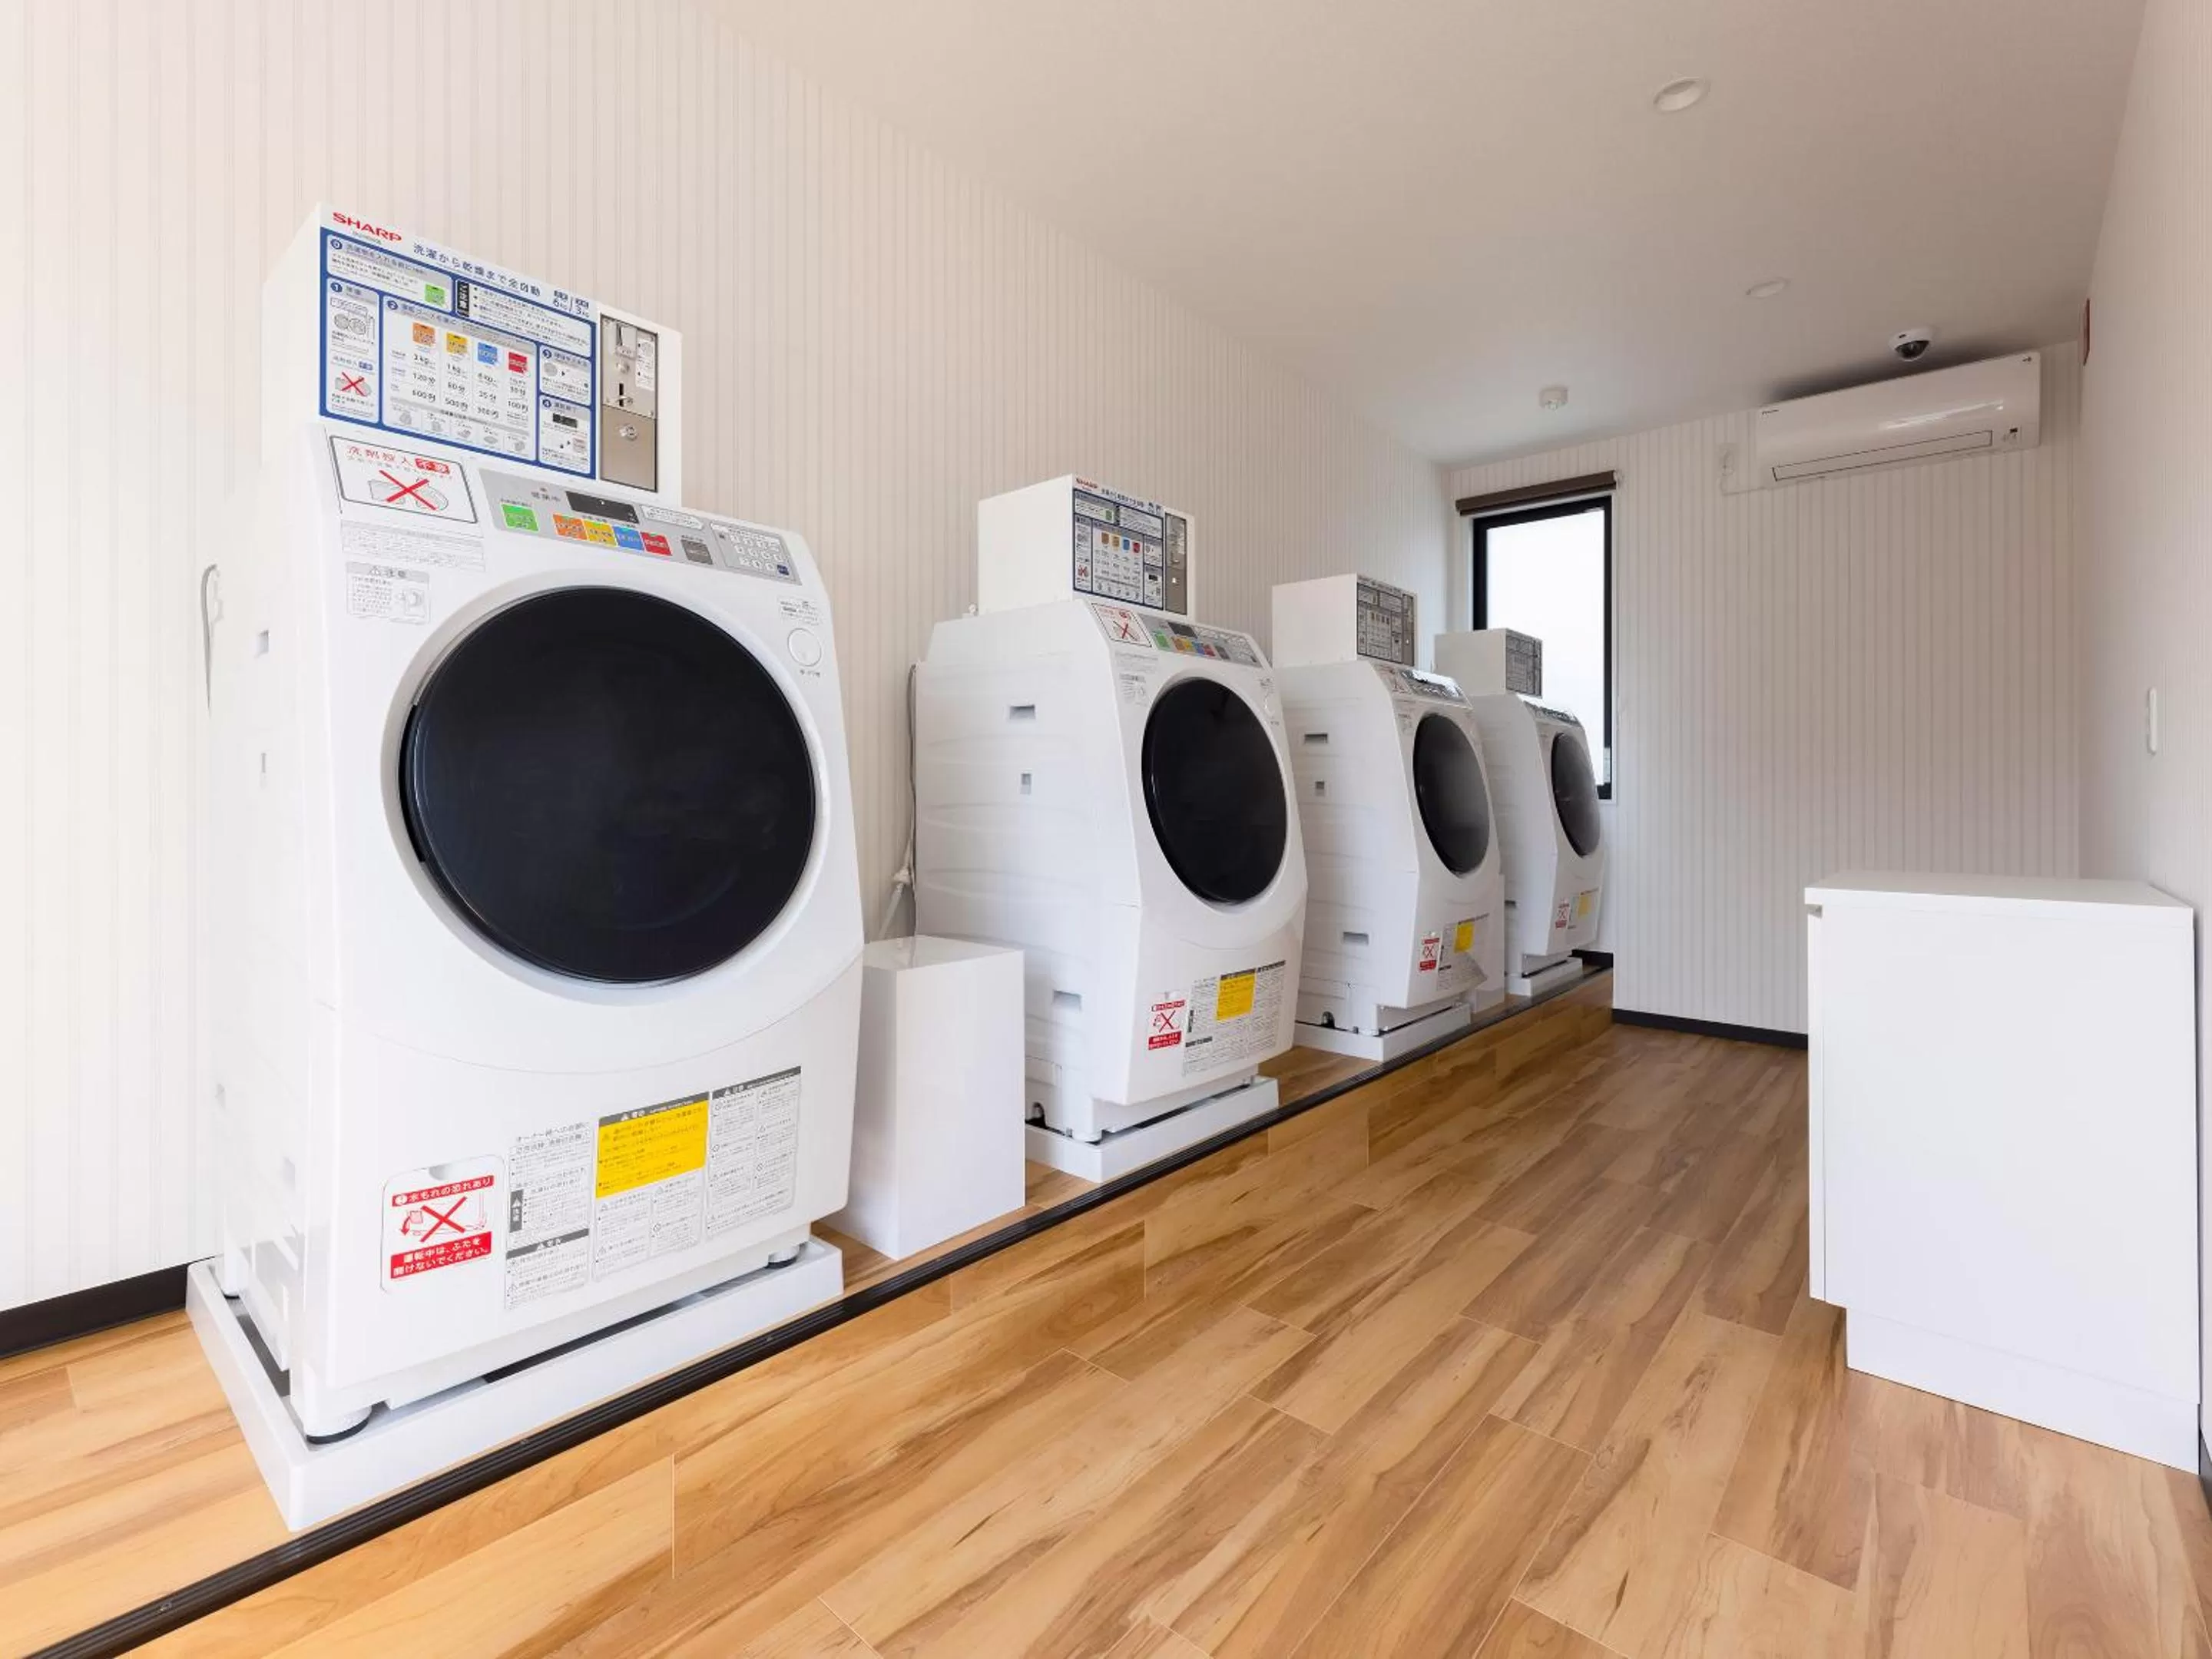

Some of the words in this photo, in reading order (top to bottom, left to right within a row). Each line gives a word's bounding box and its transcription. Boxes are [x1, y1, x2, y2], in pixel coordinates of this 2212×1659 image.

[333, 212, 402, 241] SHARP
[413, 241, 541, 297] 洗濯から乾燥まで全自動
[410, 1177, 492, 1201] 水もれの恐れあり
